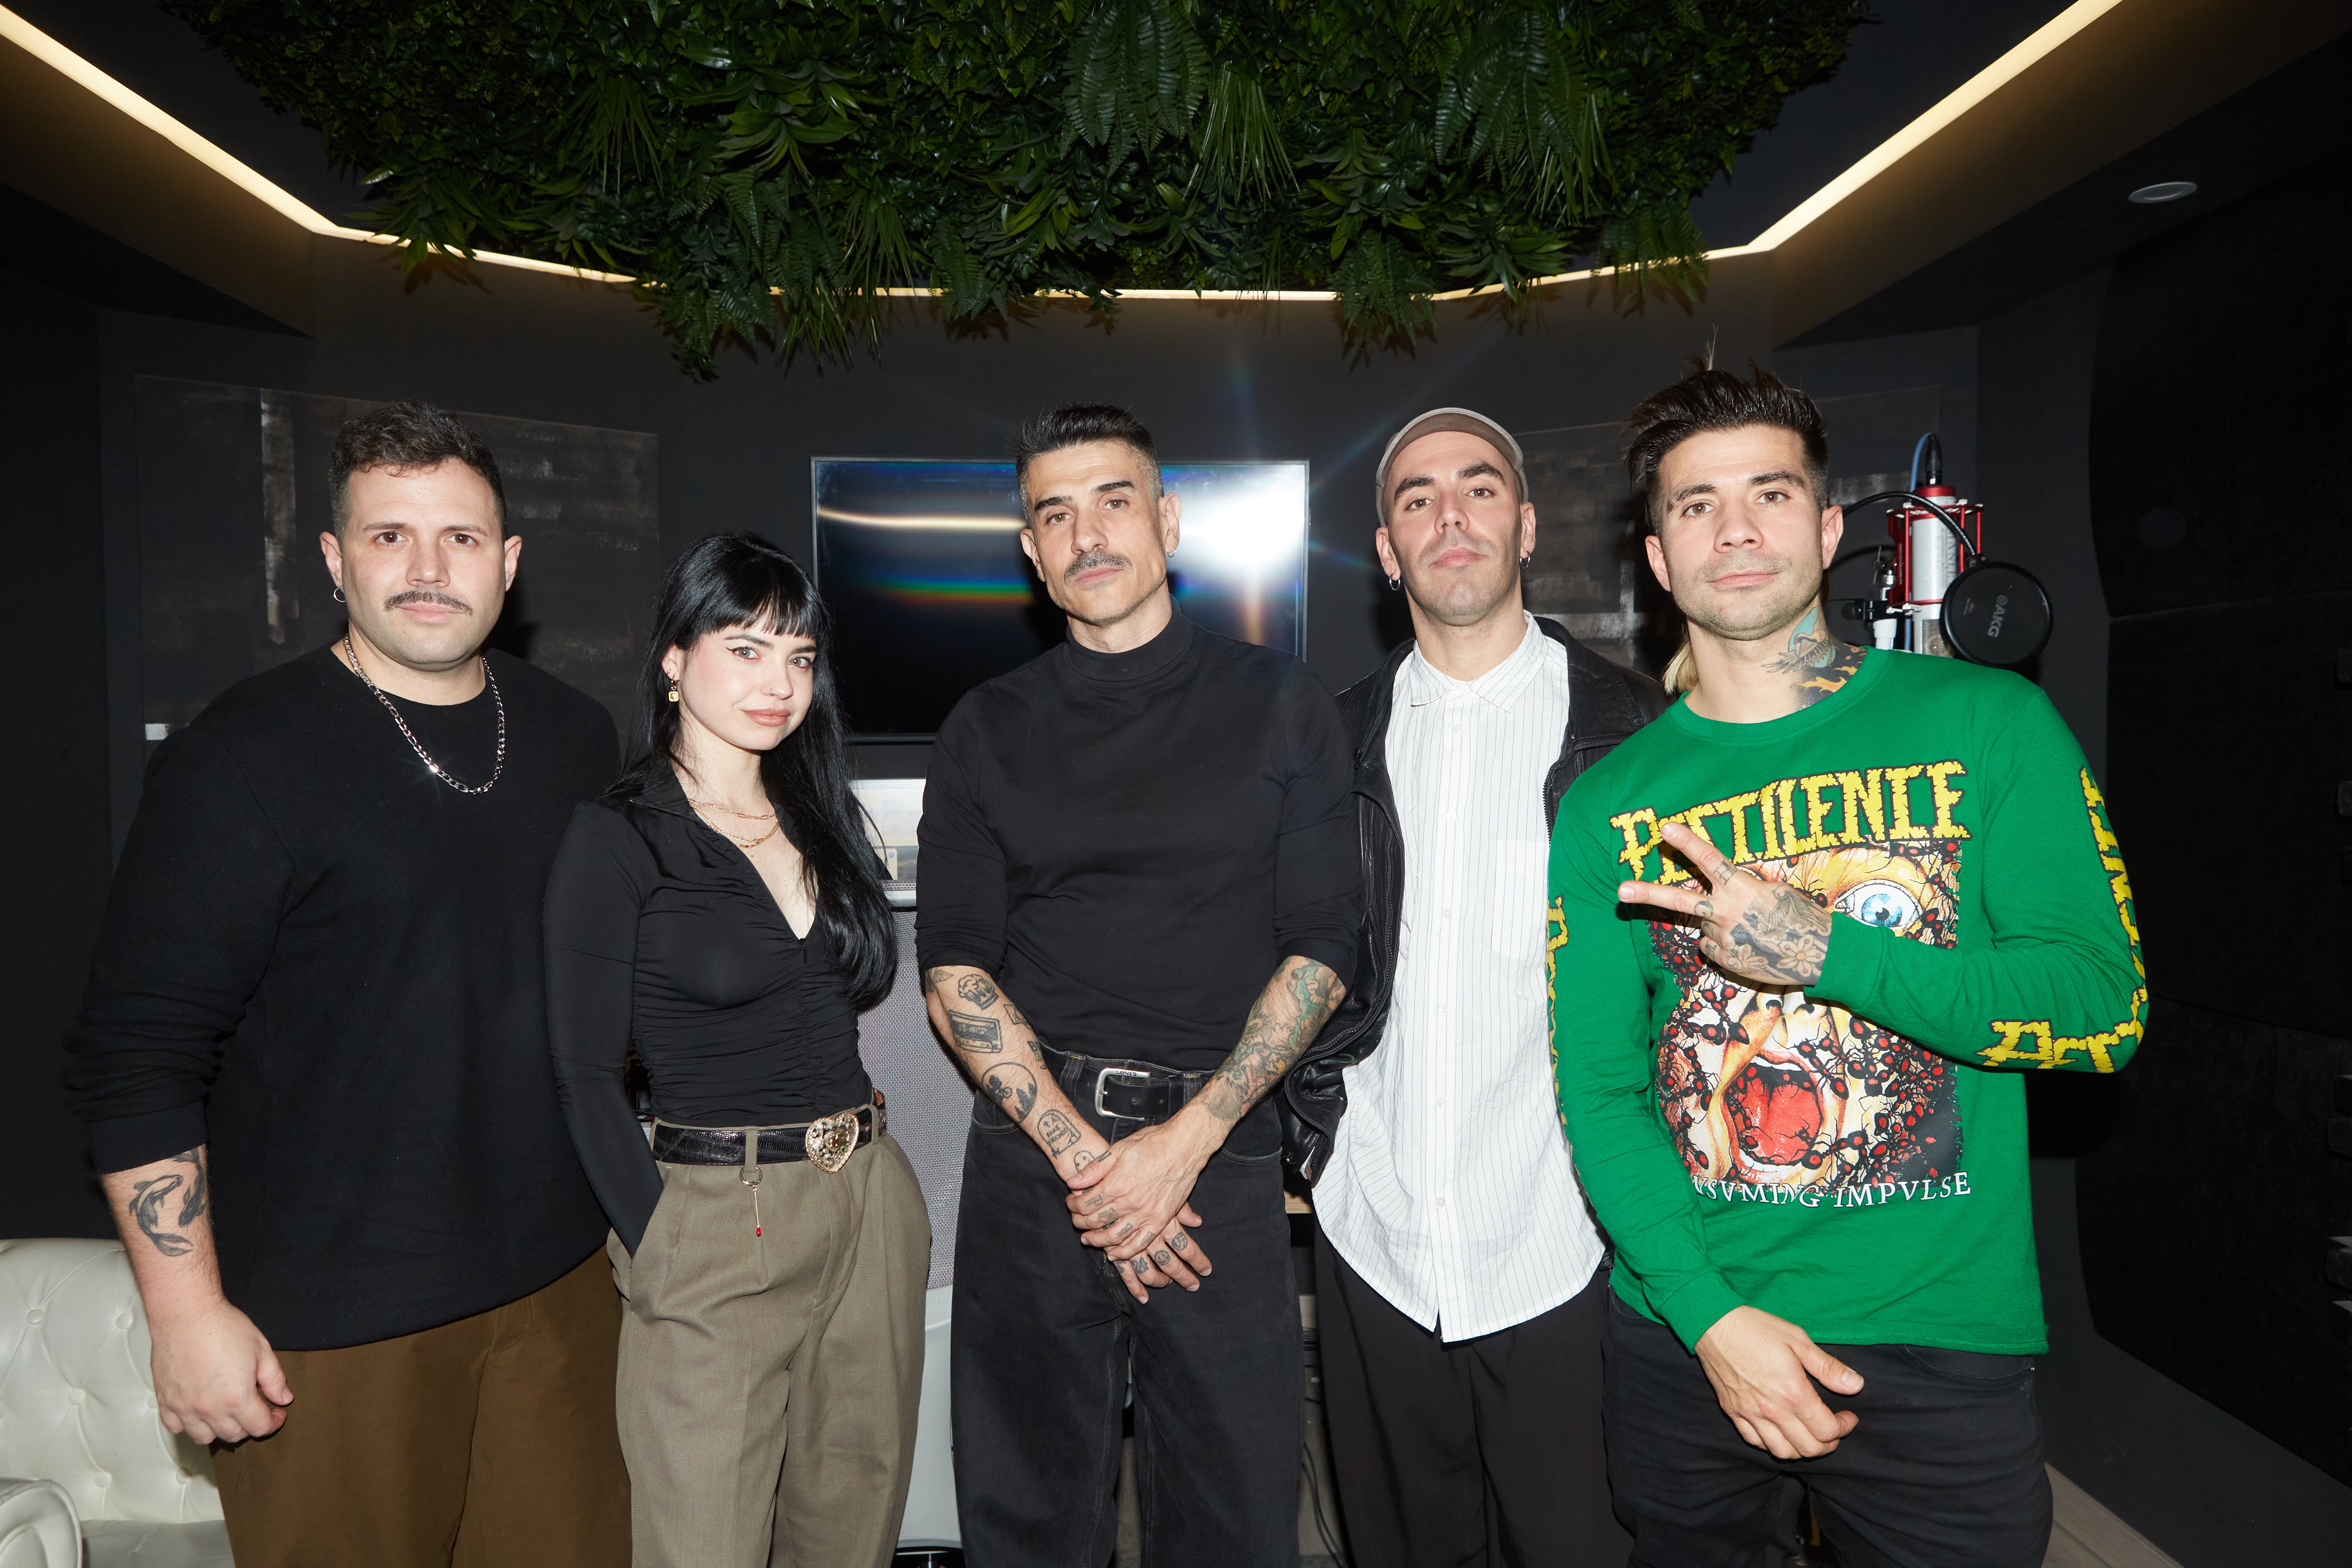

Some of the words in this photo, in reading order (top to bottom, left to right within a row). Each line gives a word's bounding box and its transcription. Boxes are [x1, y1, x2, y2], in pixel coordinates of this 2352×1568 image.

[1987, 604, 2005, 637] AKG
[1046, 1124, 1061, 1138] FAKE
[1048, 1127, 1069, 1146] FRIENDS
